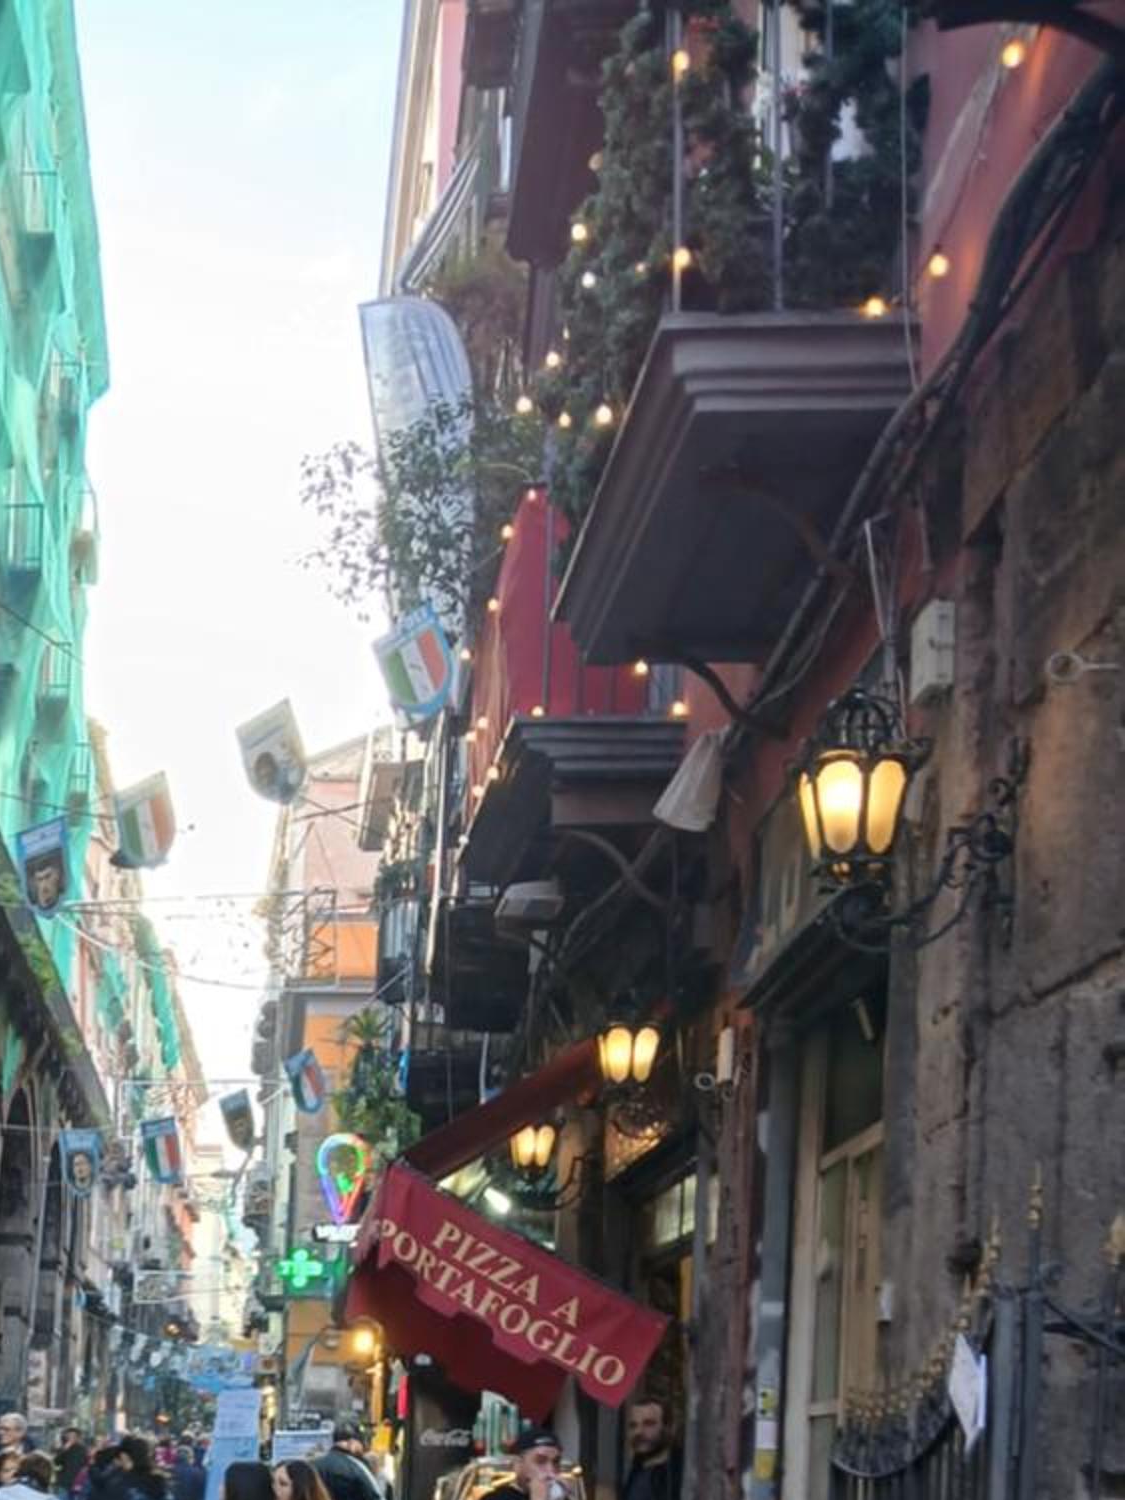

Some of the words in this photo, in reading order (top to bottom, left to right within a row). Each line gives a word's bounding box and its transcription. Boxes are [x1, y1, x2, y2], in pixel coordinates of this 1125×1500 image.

[379, 1219, 627, 1386] PORTAFOGLIO
[433, 1221, 541, 1304] PIZZA
[552, 1296, 581, 1328] A
